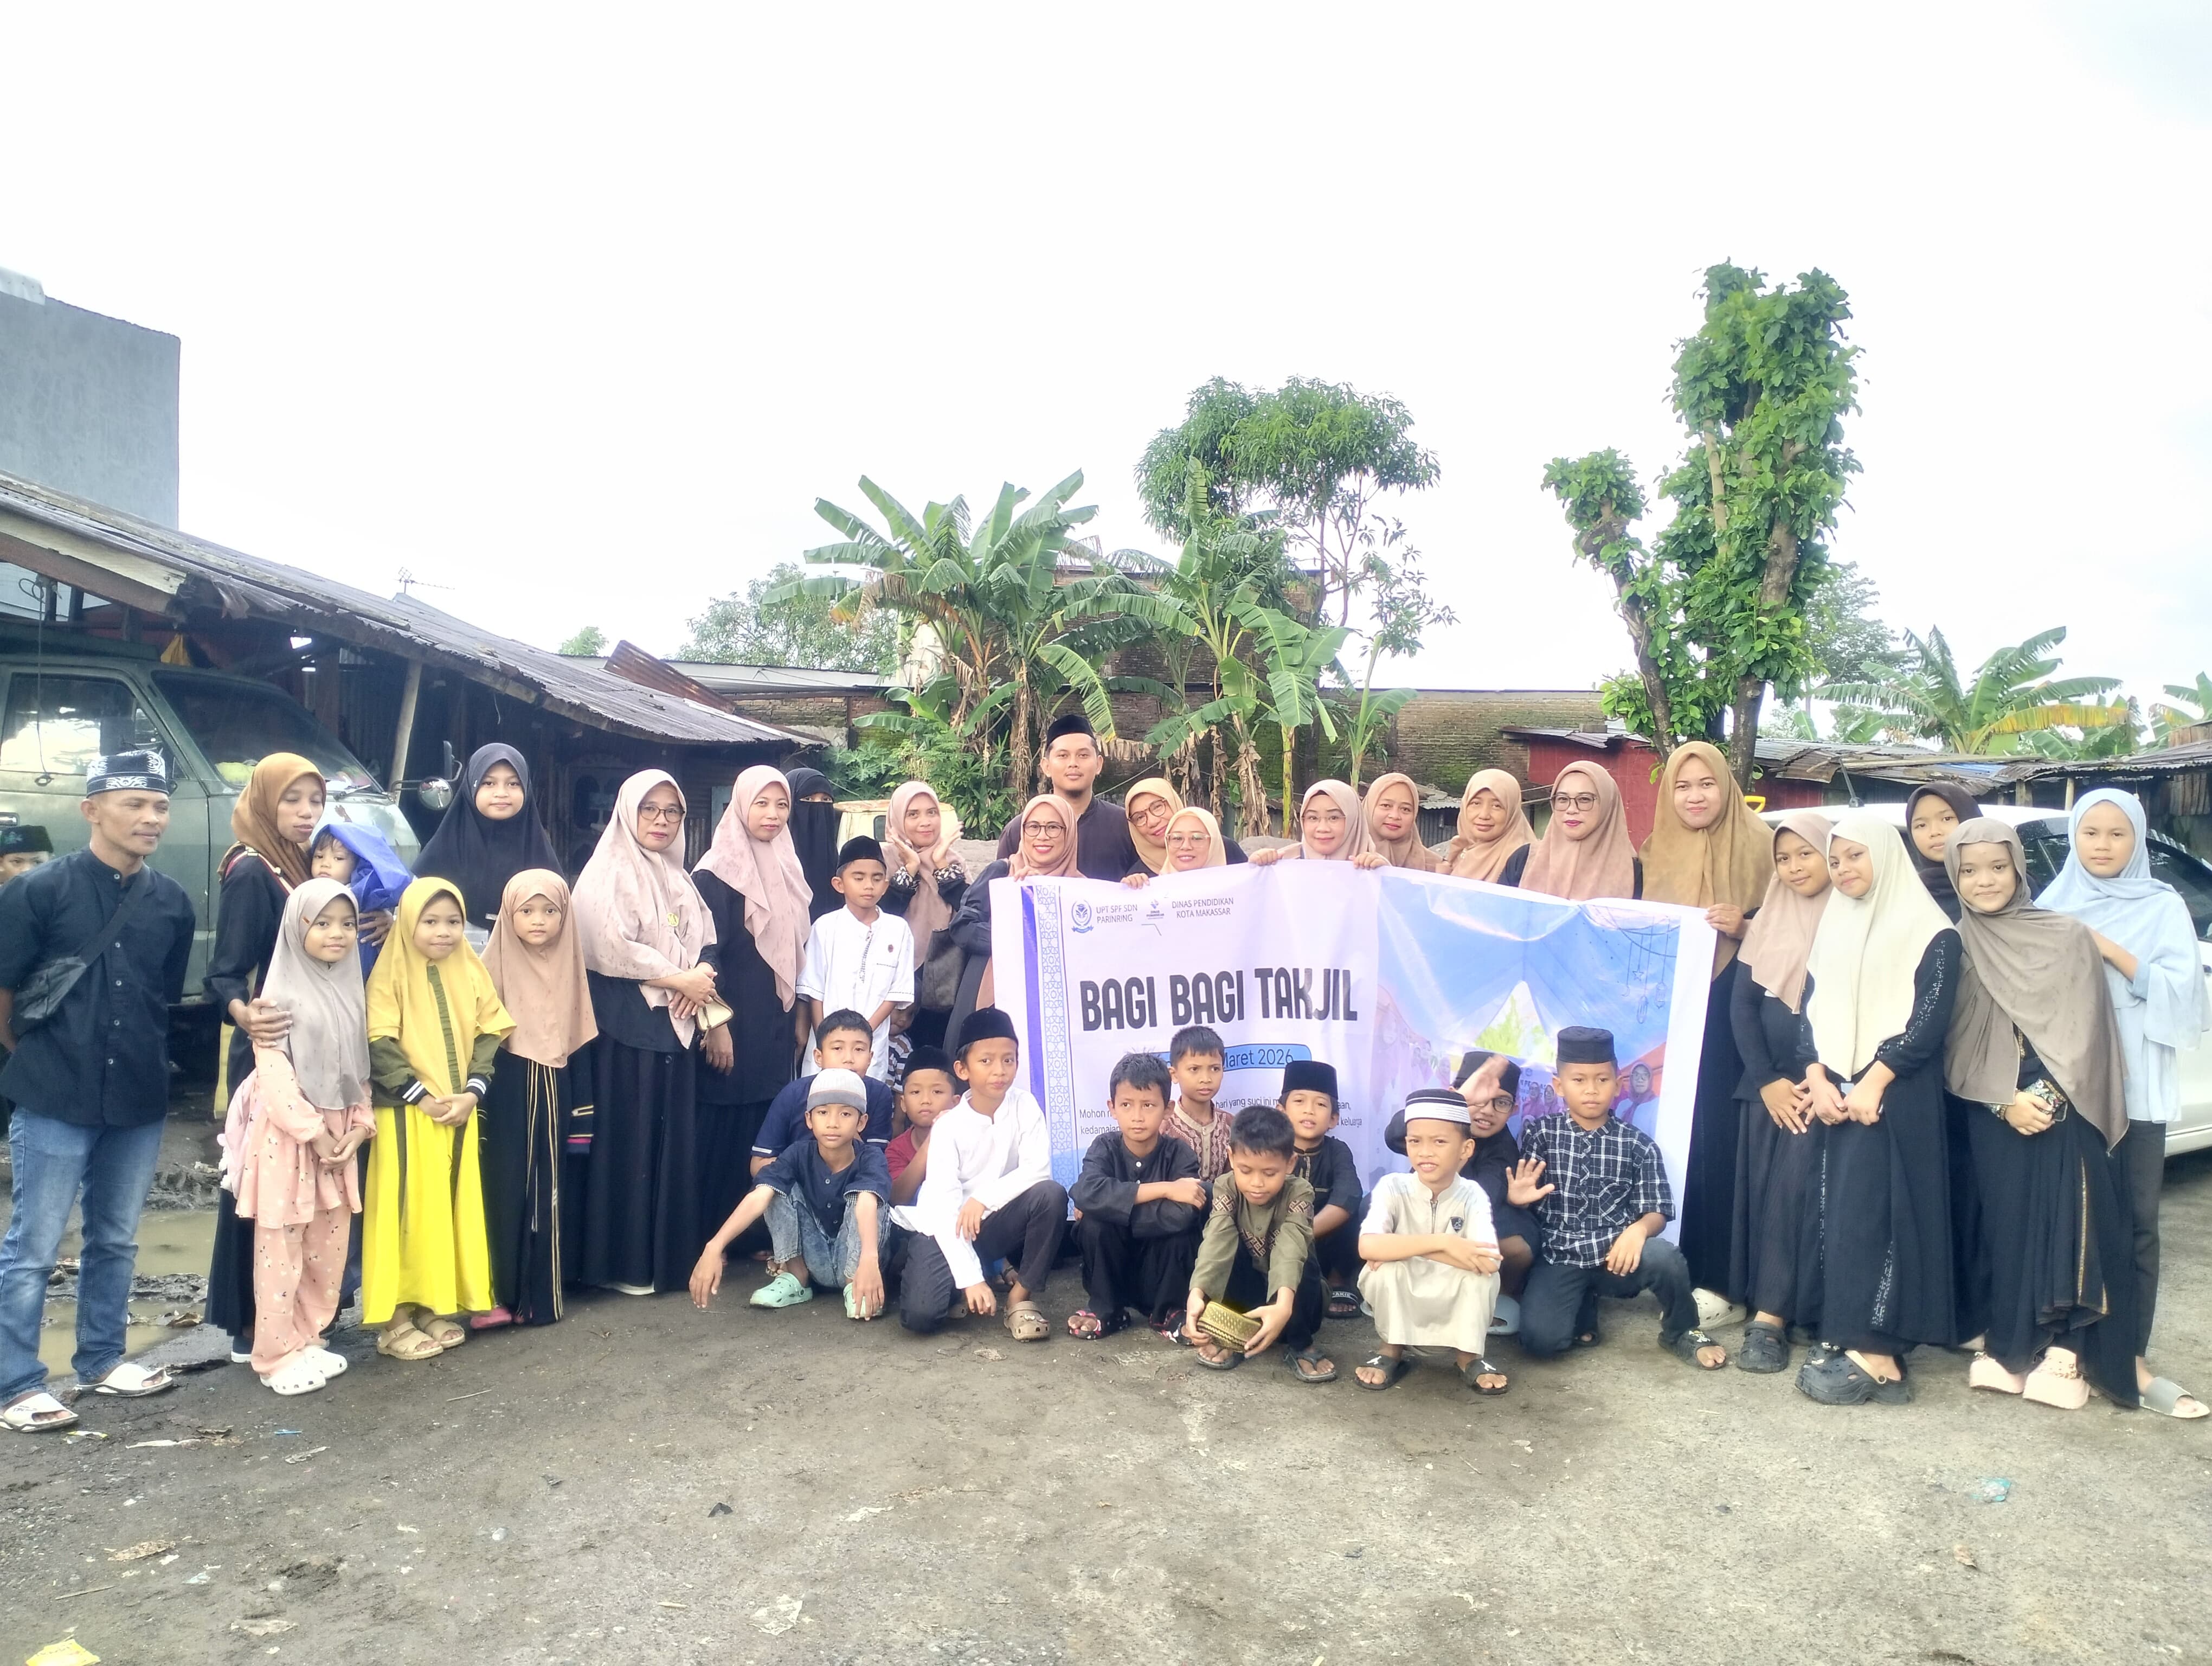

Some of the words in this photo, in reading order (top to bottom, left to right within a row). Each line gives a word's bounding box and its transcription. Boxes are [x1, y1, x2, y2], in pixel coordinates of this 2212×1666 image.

[1172, 900, 1192, 908] DINAS
[1193, 897, 1234, 907] PENDIDIKAN
[1096, 906, 1109, 914] UPT
[1176, 910, 1194, 918] KOTA
[1195, 907, 1231, 917] MAKASSAR
[1097, 914, 1133, 924] PARINRING
[1080, 976, 1158, 1031] BAGI
[1169, 970, 1245, 1026] BAGI
[1254, 967, 1358, 1021] TAKJIL
[1258, 1048, 1294, 1065] 2026
[1079, 1109, 1106, 1118] Mohon
[1216, 1098, 1228, 1108] hari
[1229, 1098, 1246, 1109] yang
[1247, 1097, 1262, 1106] suci
[1263, 1097, 1272, 1106] ini
[1340, 1117, 1362, 1128] keluarga
